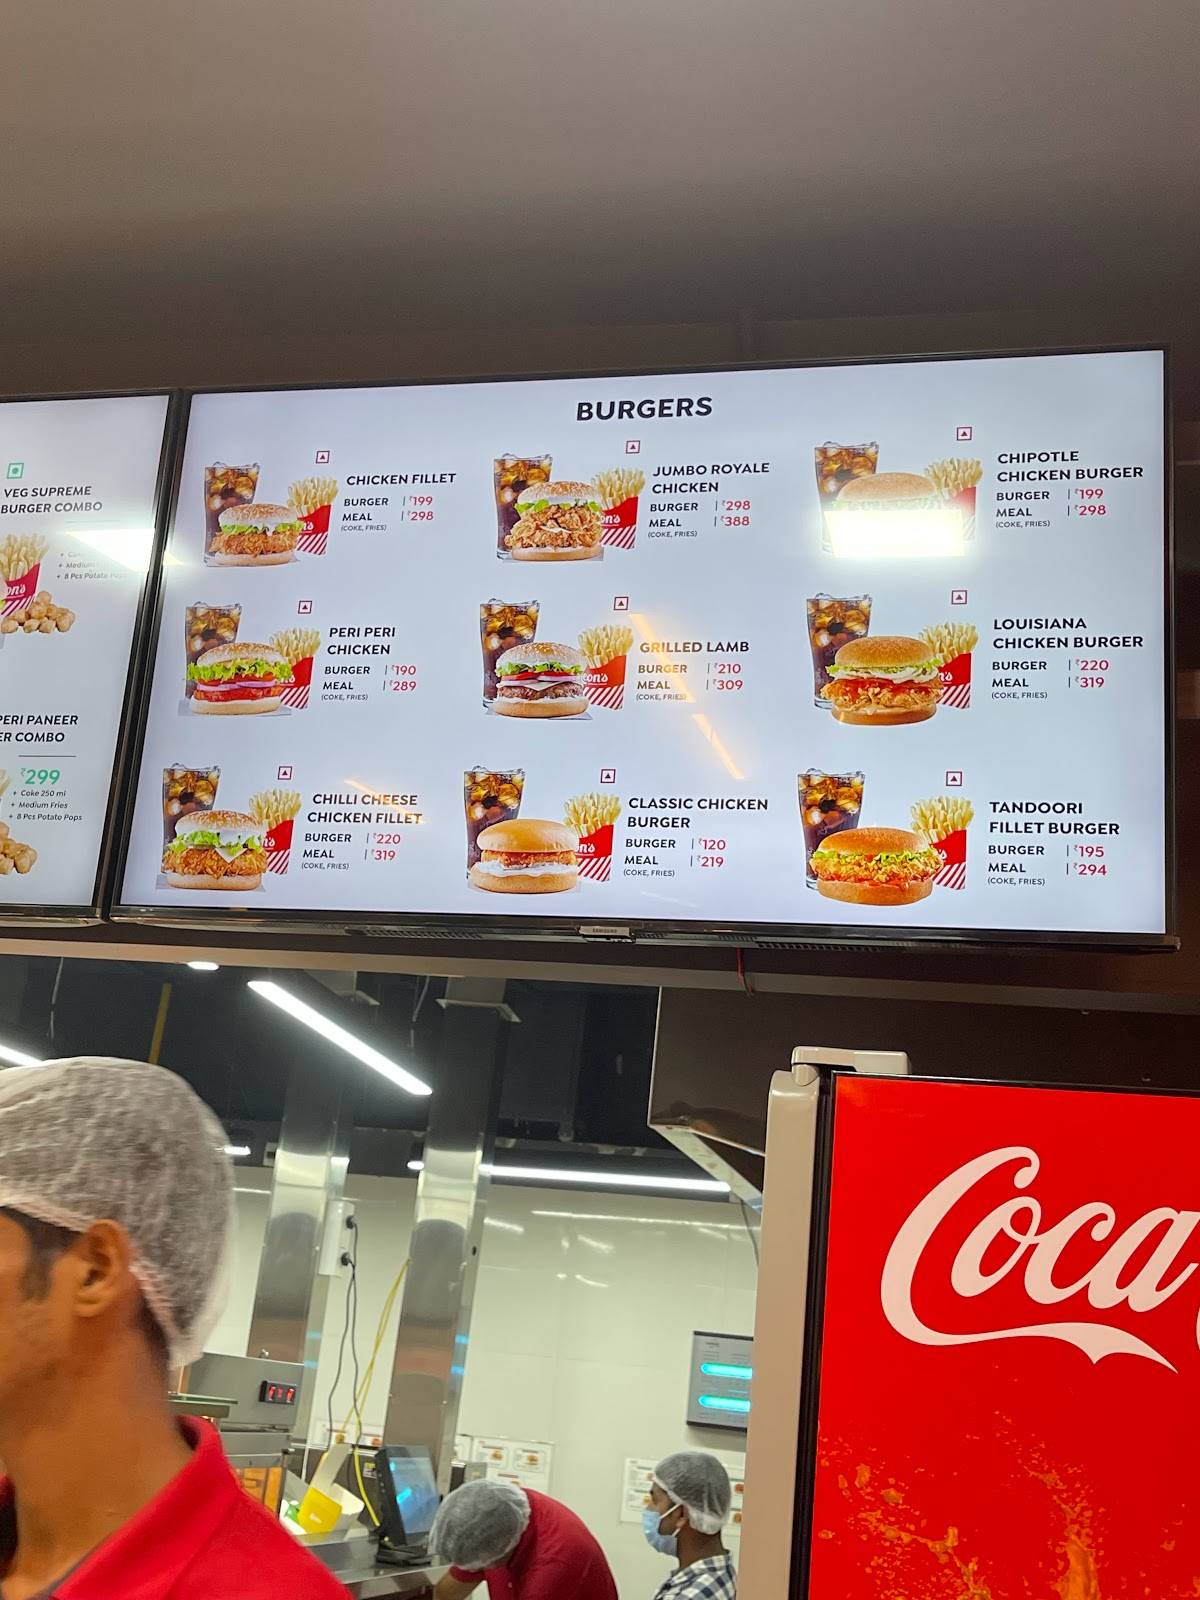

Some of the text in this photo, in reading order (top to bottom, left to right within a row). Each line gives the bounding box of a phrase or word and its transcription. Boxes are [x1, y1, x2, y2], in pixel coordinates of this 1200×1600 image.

[577, 397, 713, 421] BURGERS
[997, 451, 1079, 464] CHIPOTLE
[652, 463, 770, 477] JUMBO ROYALE
[997, 467, 1143, 482] CHICKEN BURGER
[346, 473, 456, 486] CHICKEN FILLET
[4, 486, 92, 498] VEG SUPREME
[652, 482, 719, 494] CHICKEN
[996, 491, 1050, 501] BURGER
[344, 497, 389, 507] BURGER
[1, 502, 103, 514] BURGER COMBO
[650, 503, 699, 512] BURGER
[996, 508, 1032, 517] MEAL
[342, 513, 372, 521] MEAL
[341, 524, 364, 532] (COKE,
[649, 519, 681, 528] MEAL
[993, 618, 1087, 630] LOUISIANA
[329, 627, 395, 638] PERI PERI
[640, 641, 749, 653] GRILLED LAMB
[993, 636, 1143, 649] CHICKEN BURGER
[327, 645, 390, 655] CHICKEN
[324, 666, 370, 675] BURGER
[638, 664, 687, 673] BURGER
[992, 661, 1047, 671] BURGER
[323, 682, 353, 690] MEAL
[637, 681, 670, 689] MEAL
[992, 678, 1029, 687] MEAL
[992, 691, 1048, 699] (COKE, FRIES)
[27, 715, 78, 725] PANEER
[15, 732, 65, 742] COMBO
[313, 794, 418, 806] CHILLI CHEESE
[628, 797, 768, 810] CLASSIC CHICKEN
[989, 802, 1083, 814] TANDOORI
[307, 812, 423, 824] CHICKEN FILLET
[628, 816, 690, 828] BURGER
[989, 822, 1120, 835] FILLET BURGER
[305, 833, 351, 843] BURGER
[625, 839, 676, 848] BURGER
[303, 850, 334, 859] MEAL
[989, 845, 1045, 855] BURGER
[624, 856, 658, 865] MEAL
[988, 863, 1026, 872] MEAL
[624, 869, 675, 877] (COKE, FRIES)
[987, 878, 1045, 886] (COKE, FRIES)
[880, 1146, 1200, 1374] Coca
